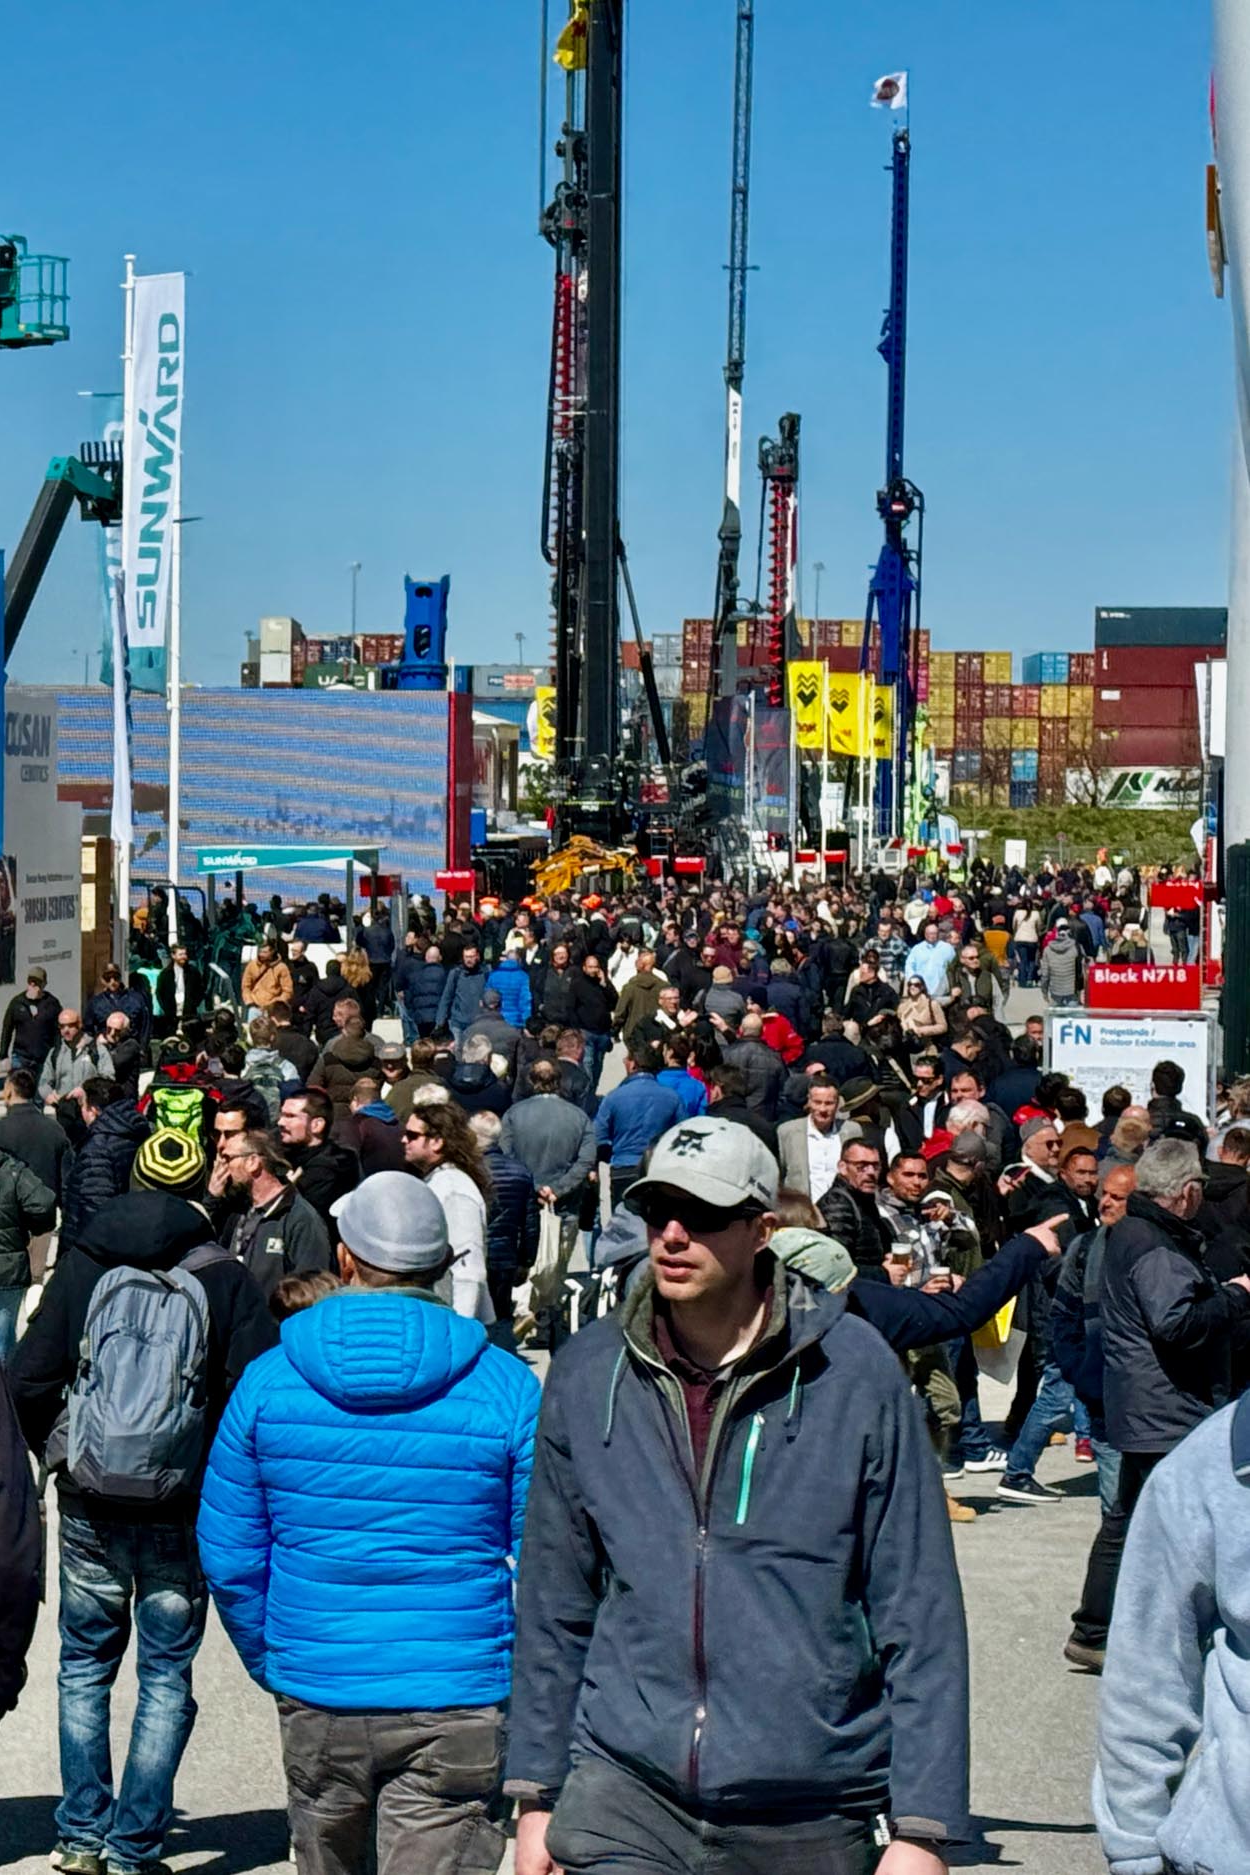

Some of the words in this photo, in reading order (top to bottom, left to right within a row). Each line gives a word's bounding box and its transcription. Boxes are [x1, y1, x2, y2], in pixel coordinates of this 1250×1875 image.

[1094, 967, 1139, 983] Block
[1142, 968, 1187, 983] N718
[1060, 1024, 1092, 1045] FN
